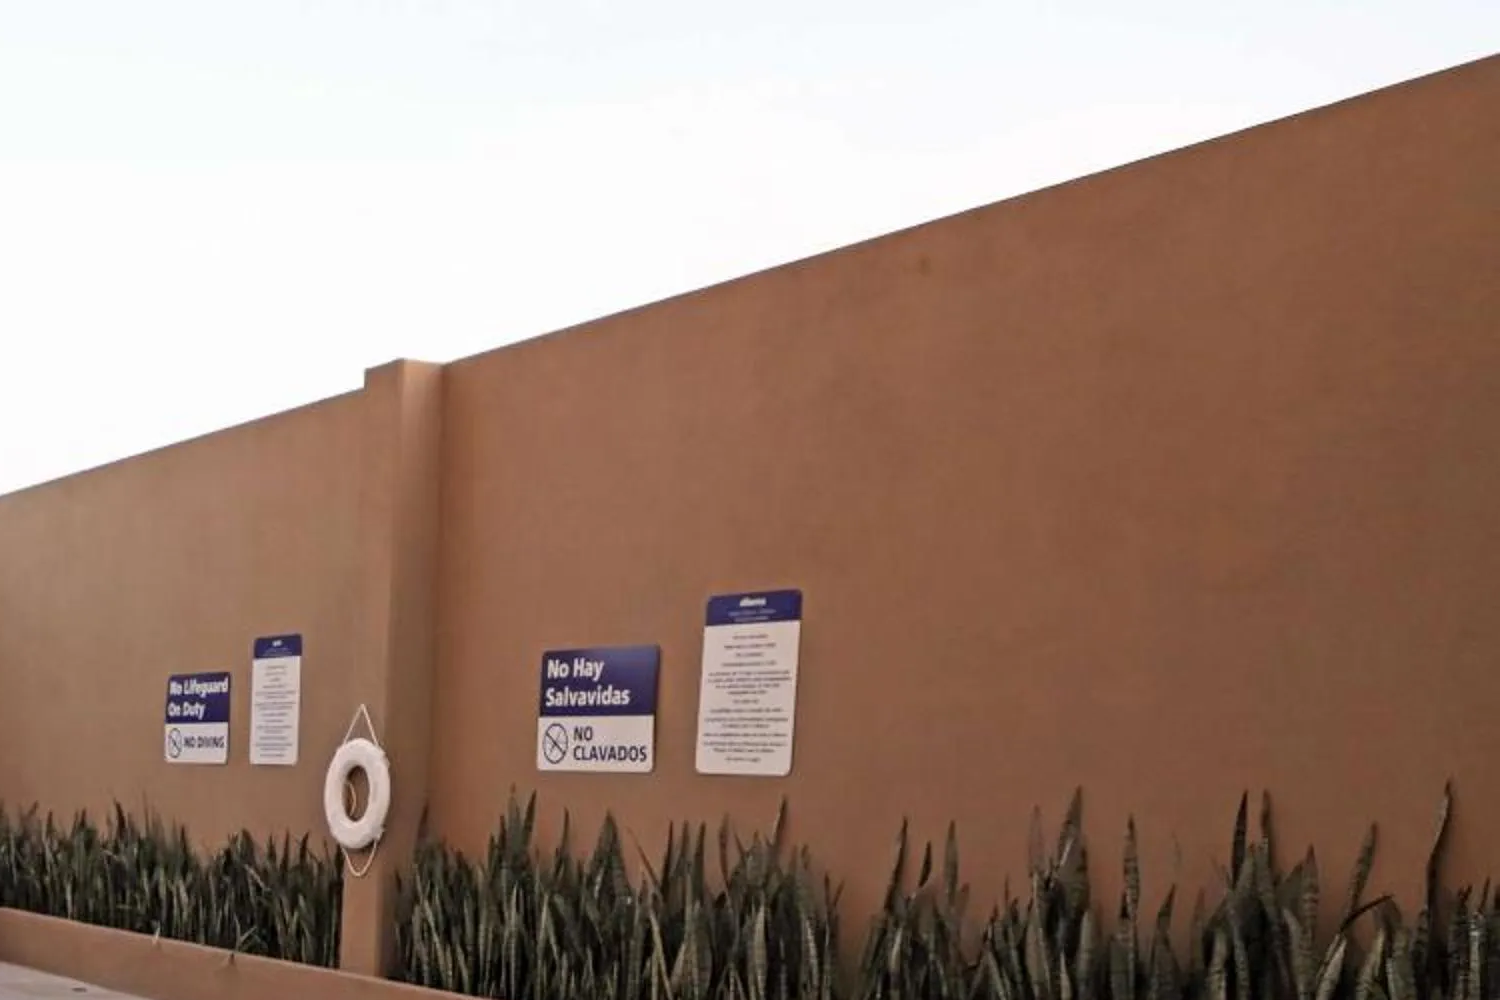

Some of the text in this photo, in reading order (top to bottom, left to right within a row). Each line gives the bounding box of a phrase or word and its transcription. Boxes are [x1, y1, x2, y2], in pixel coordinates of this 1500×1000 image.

[547, 657, 605, 682] No Hay
[170, 681, 183, 695] No
[545, 684, 631, 707] Salvavidas
[168, 701, 206, 720] On Duty
[573, 725, 594, 741] NO
[573, 745, 648, 762] CLAVADOS
